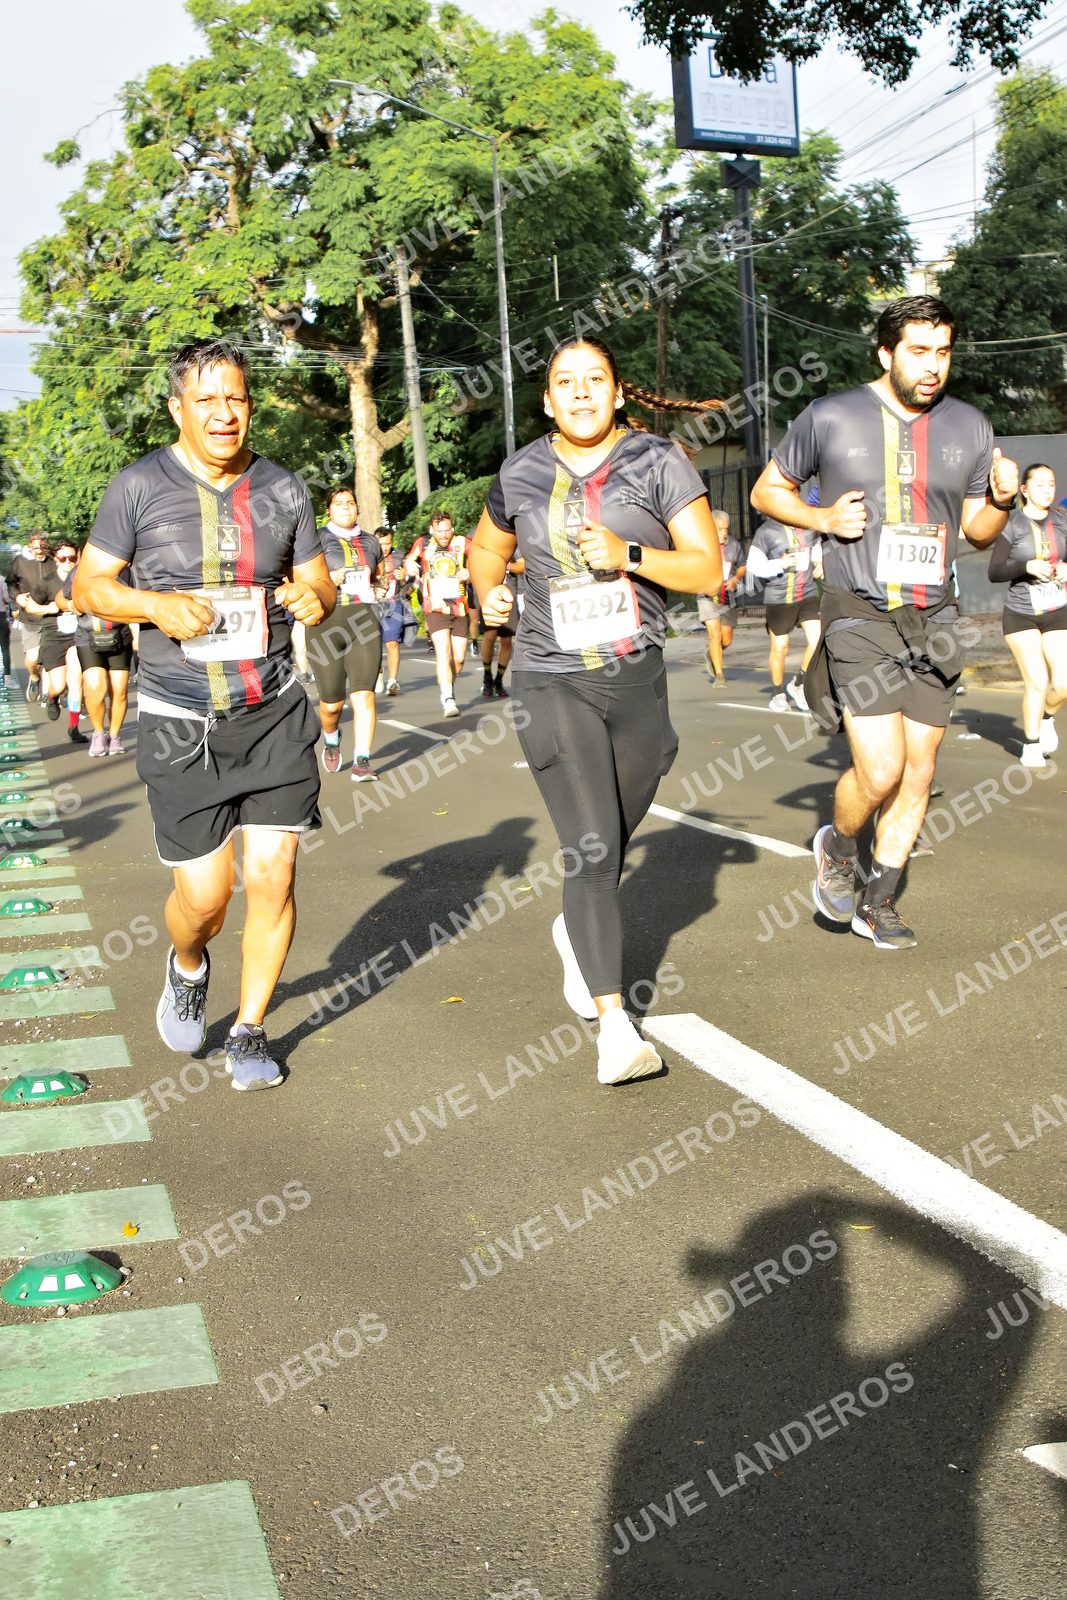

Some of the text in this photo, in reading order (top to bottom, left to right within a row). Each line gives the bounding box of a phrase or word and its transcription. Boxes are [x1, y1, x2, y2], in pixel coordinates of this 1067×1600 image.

[886, 543, 937, 564] 11302
[556, 591, 628, 624] 12292
[208, 610, 257, 634] 297
